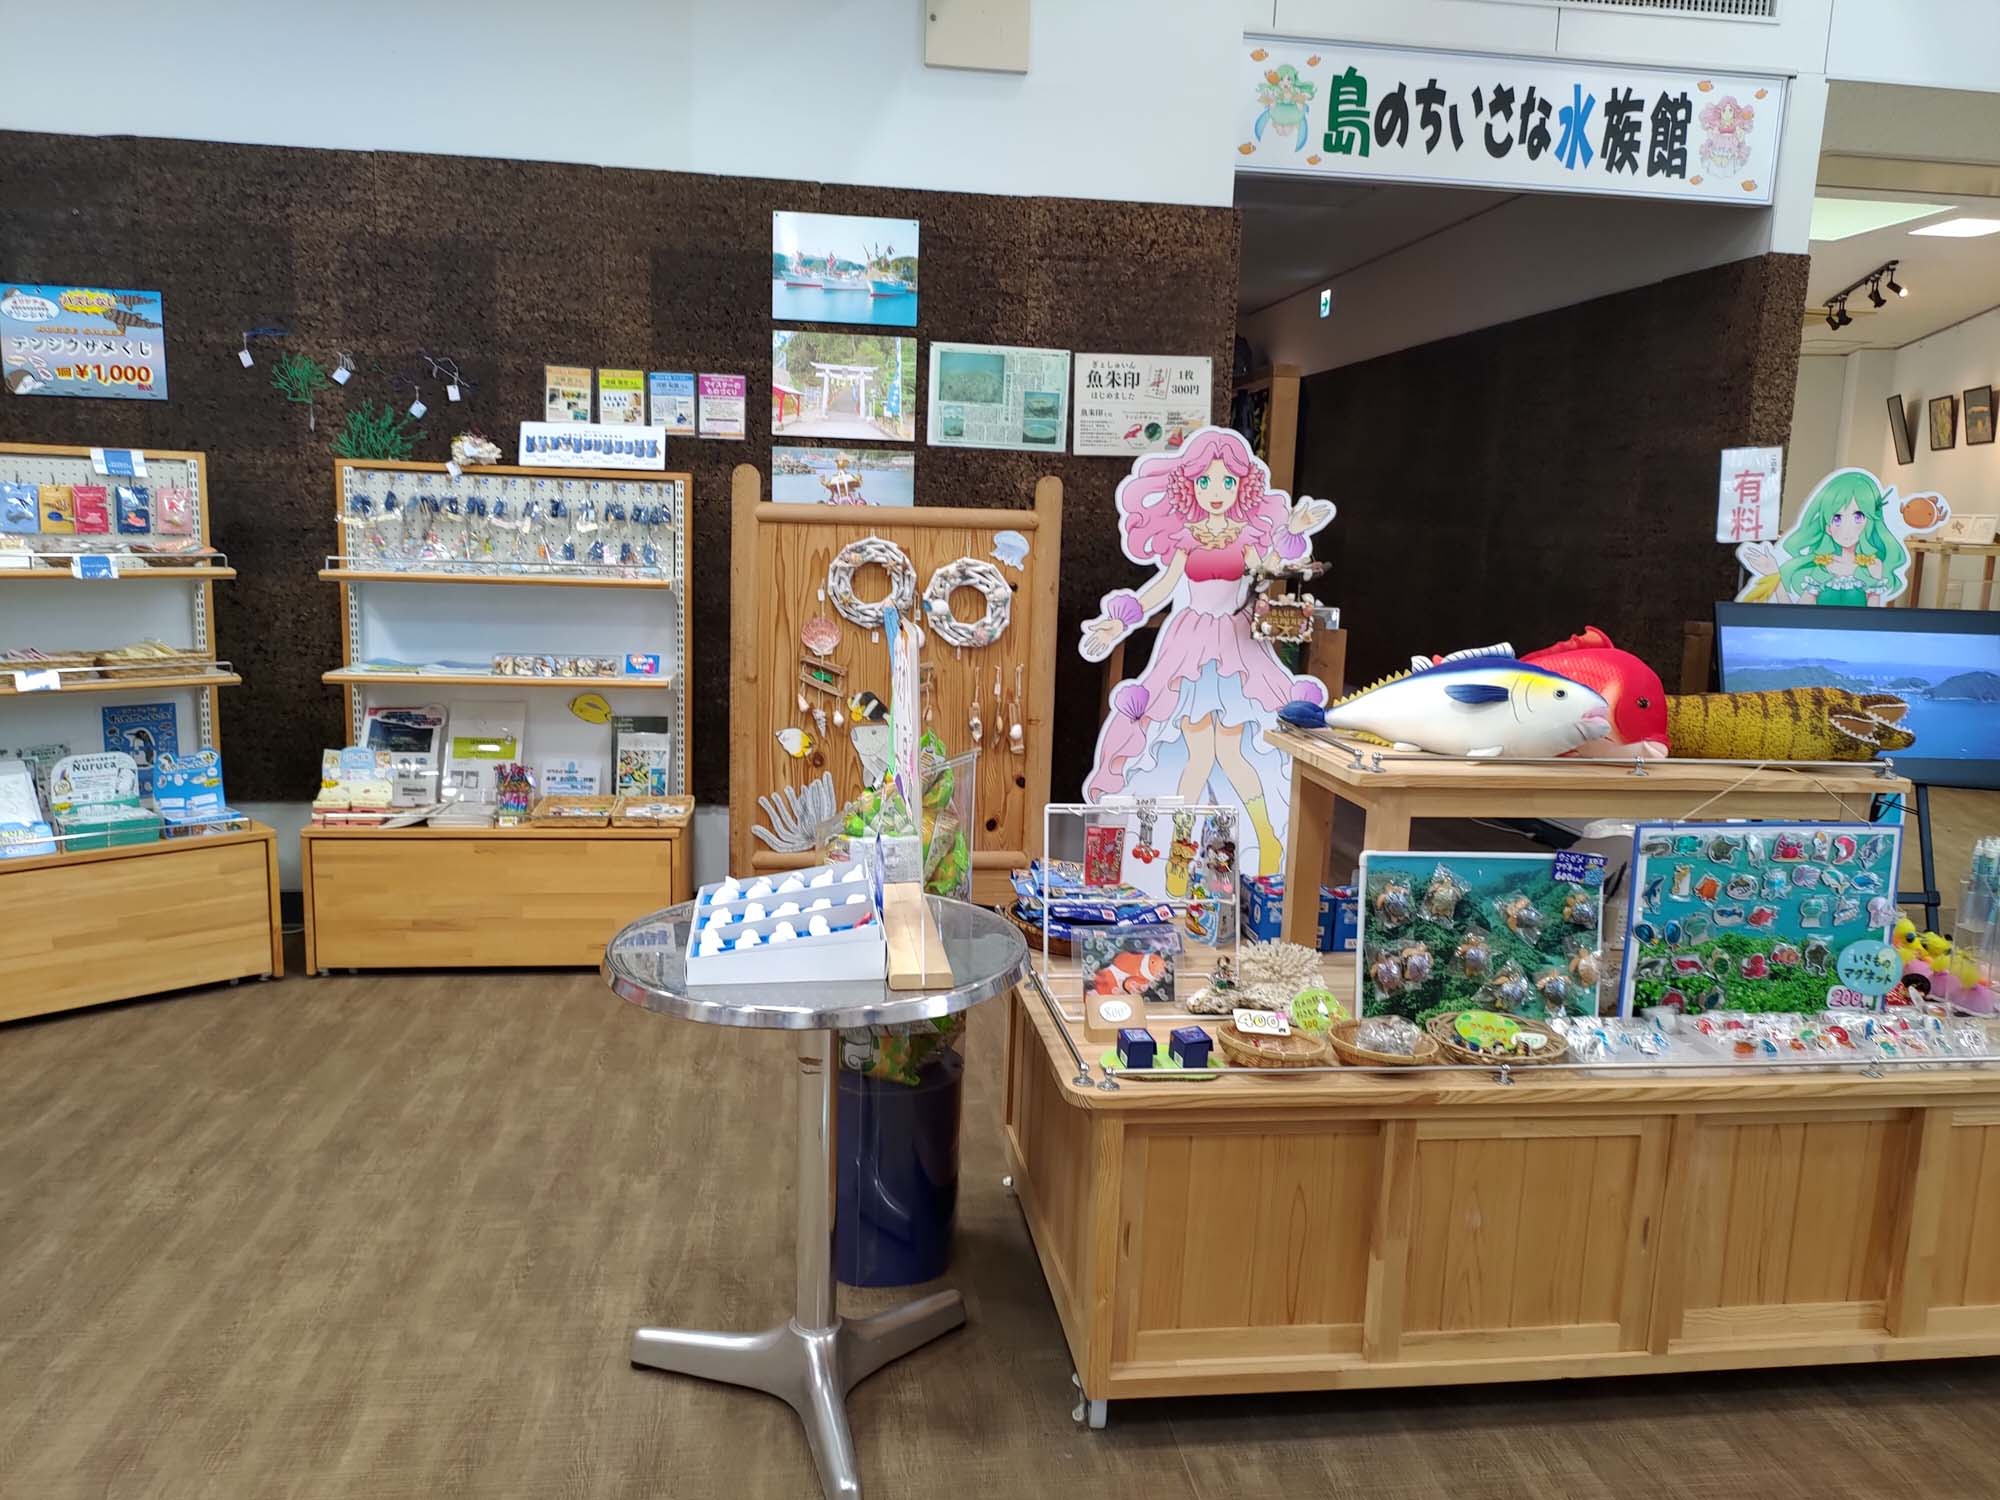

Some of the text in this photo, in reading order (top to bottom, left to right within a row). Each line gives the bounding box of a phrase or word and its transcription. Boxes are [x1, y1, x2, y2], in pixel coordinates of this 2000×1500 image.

[1323, 66, 1692, 180] 島のちいさな水族館
[1086, 369, 1141, 389] 魚朱印
[1179, 370, 1194, 380] 1枚
[1091, 391, 1136, 400] はじめました
[1171, 384, 1200, 395] 300円
[1731, 469, 1765, 541] 有料
[72, 761, 118, 773] Nuruca
[1853, 953, 1892, 969] いきもの
[1844, 968, 1893, 985] マグネット
